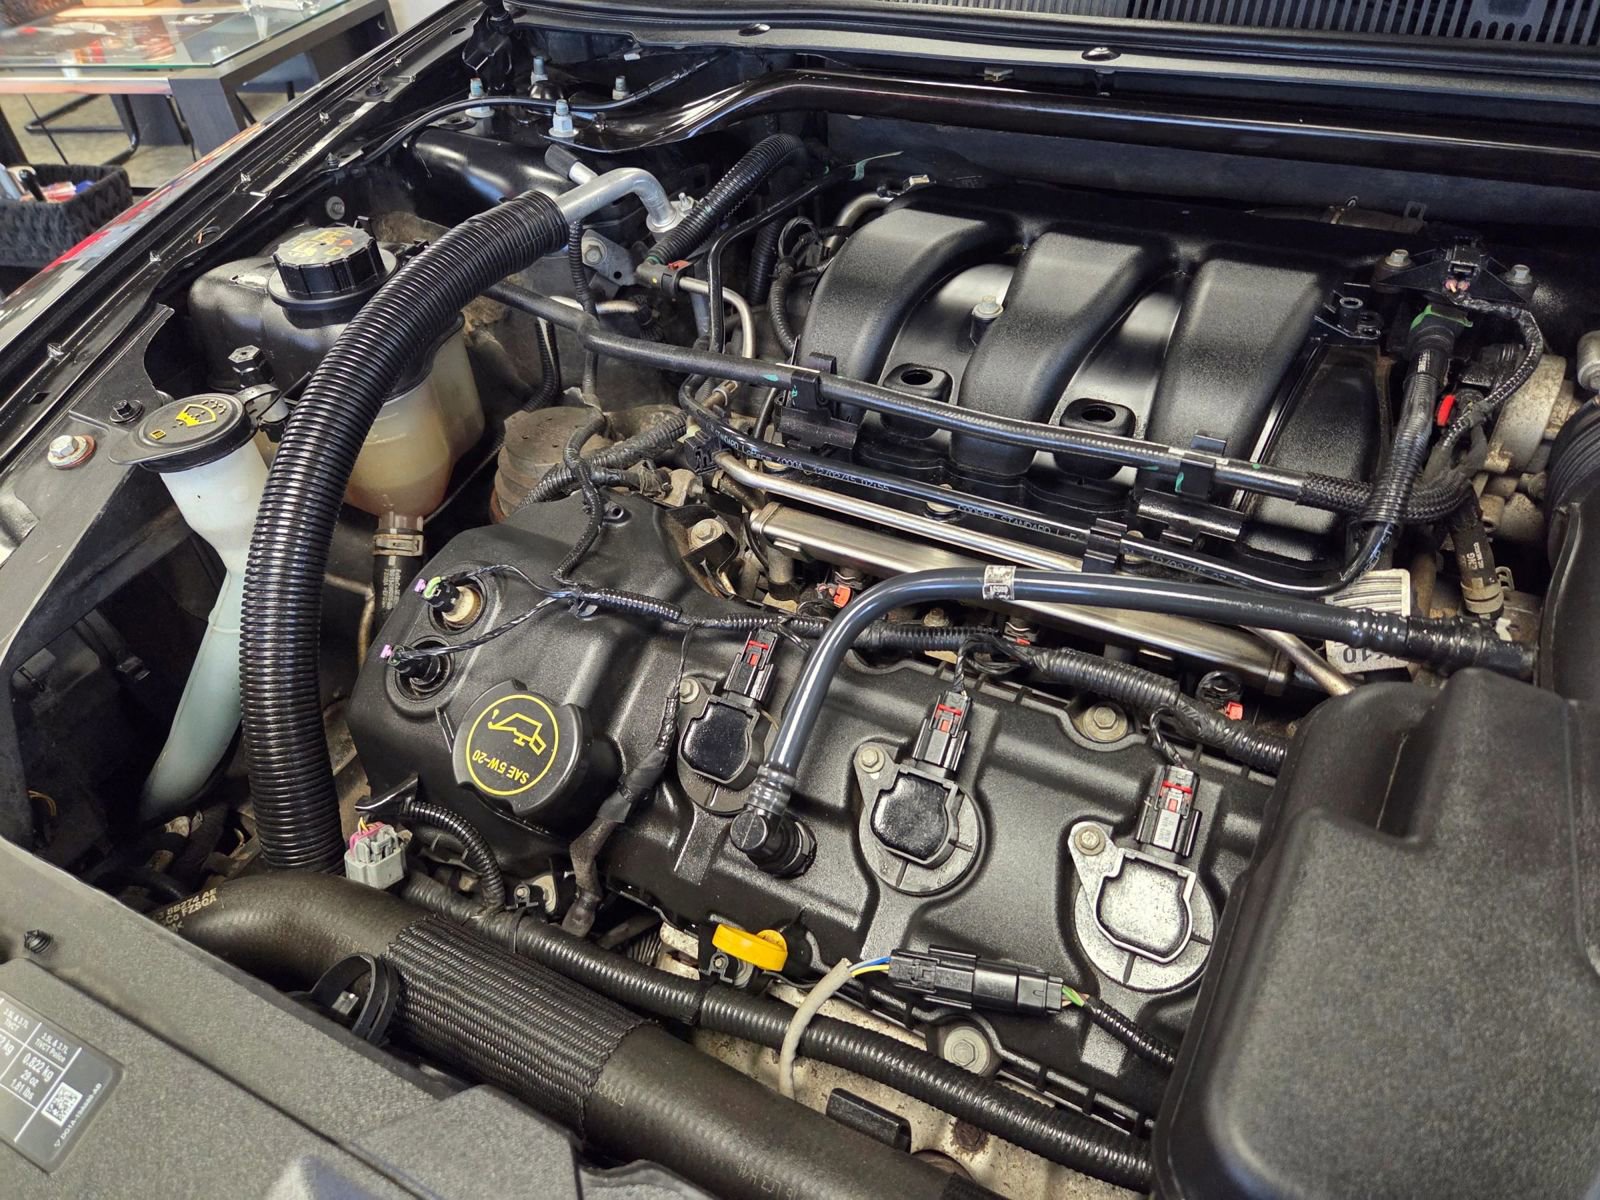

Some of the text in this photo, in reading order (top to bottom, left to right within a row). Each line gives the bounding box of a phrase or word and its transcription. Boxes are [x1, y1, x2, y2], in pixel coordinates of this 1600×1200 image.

[471, 748, 531, 785] SAE 5W-20
[22, 1052, 55, 1083] 0.822 kg
